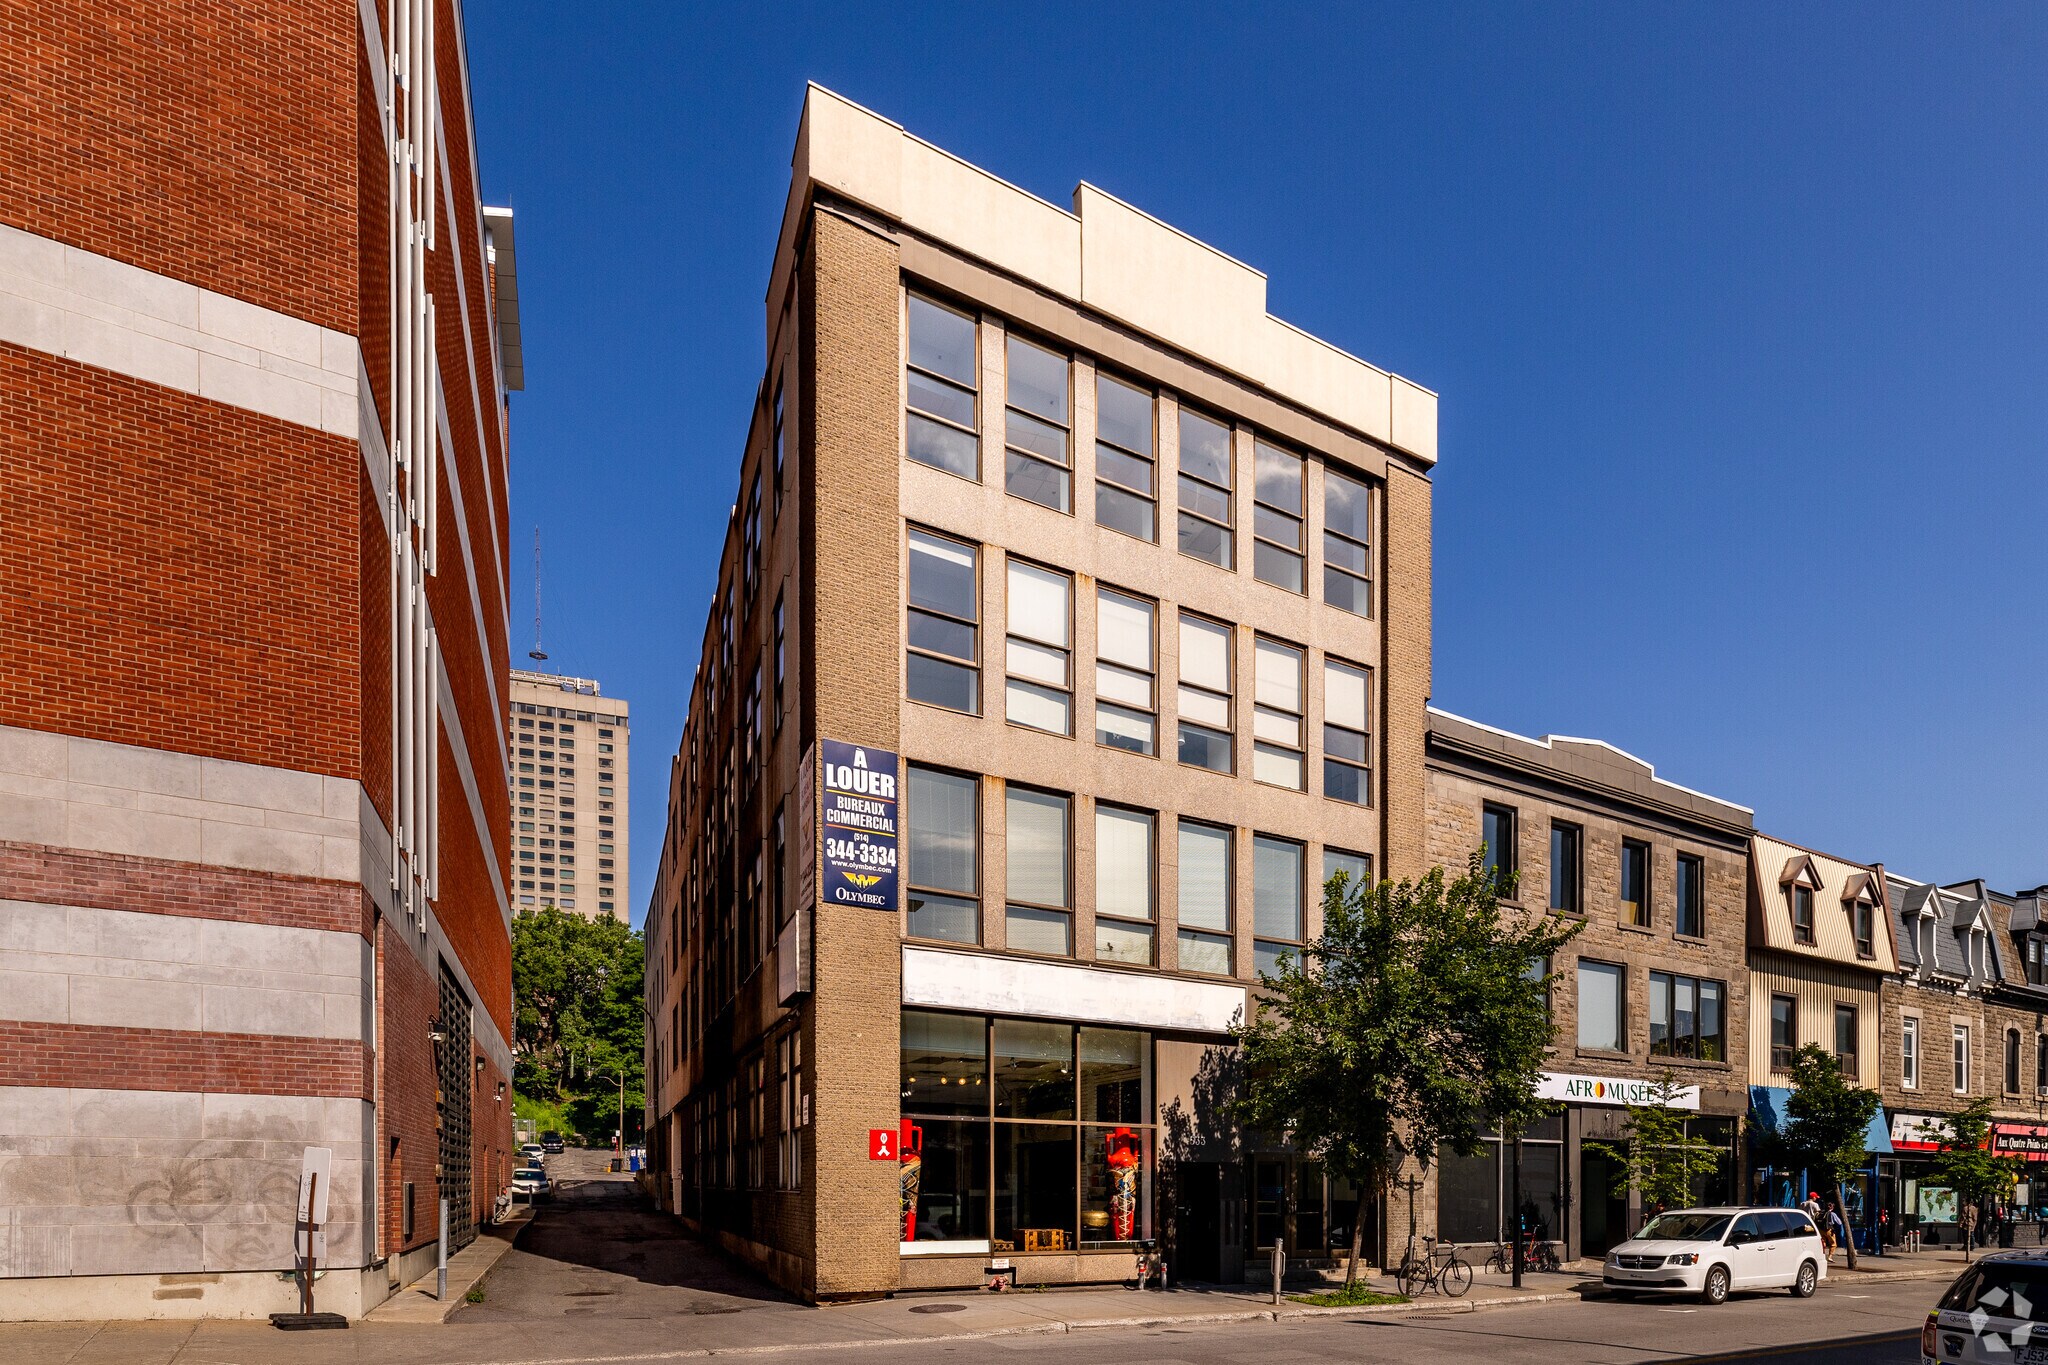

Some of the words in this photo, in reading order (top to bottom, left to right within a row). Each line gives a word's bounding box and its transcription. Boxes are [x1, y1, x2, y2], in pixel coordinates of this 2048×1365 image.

[853, 747, 868, 769] À
[826, 763, 895, 798] LOUER
[837, 796, 885, 817] BUREAUX
[826, 808, 895, 833] COMMERCIAL
[853, 832, 869, 844] (514)
[826, 837, 897, 867] 344-3334
[831, 859, 892, 874] www.olymbec.com
[835, 886, 886, 906] OLYMBEC
[1997, 1136, 2008, 1147] Aux
[2009, 1137, 2026, 1150] Quatre
[2026, 1138, 2041, 1149] Points
